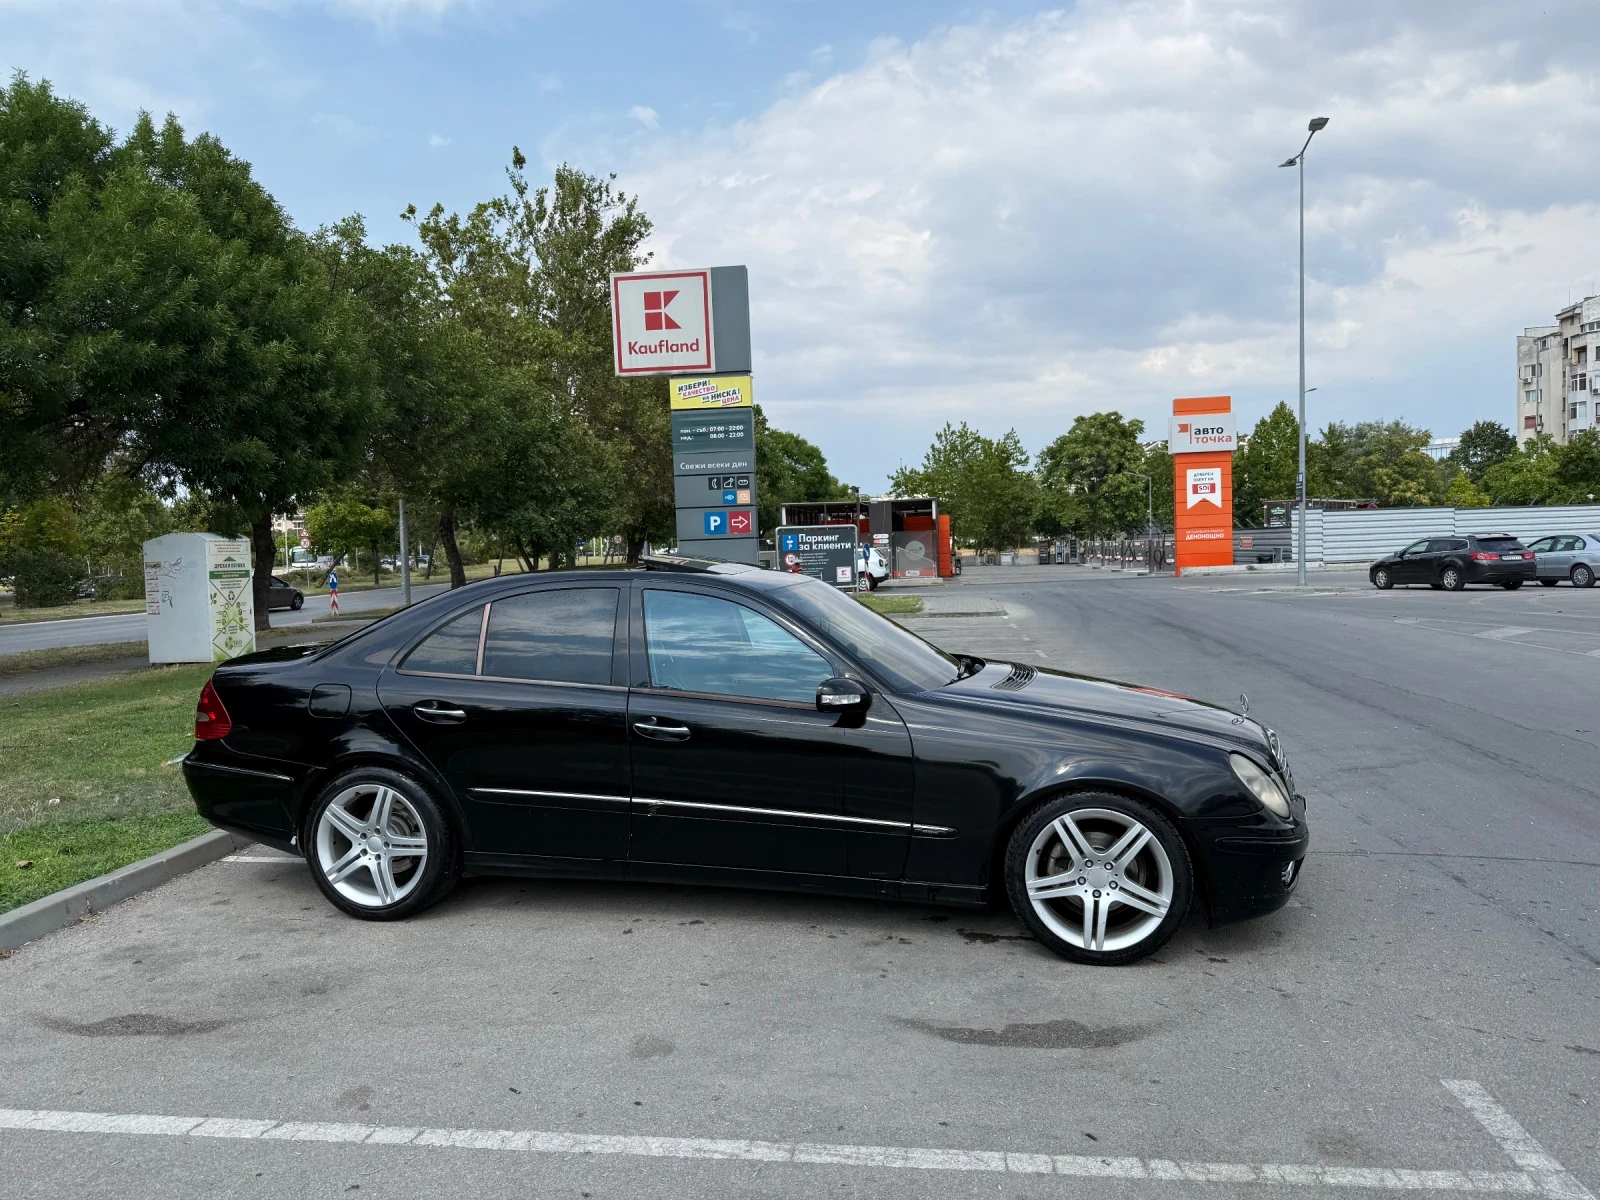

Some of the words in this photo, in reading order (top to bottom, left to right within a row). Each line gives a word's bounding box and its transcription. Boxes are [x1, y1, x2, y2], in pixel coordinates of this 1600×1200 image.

[628, 338, 698, 354] Kaufland
[678, 380, 708, 392] ИЗБЕРИ
[682, 385, 716, 397] КАЧЕСТВО
[711, 389, 737, 401] НИСКА
[721, 395, 740, 404] ЦЕНА
[1194, 426, 1224, 435] авто
[1194, 435, 1232, 444] точка
[731, 461, 748, 469] ден
[709, 516, 721, 531] P
[798, 534, 840, 544] Паркинг
[812, 542, 852, 550] клиенти
